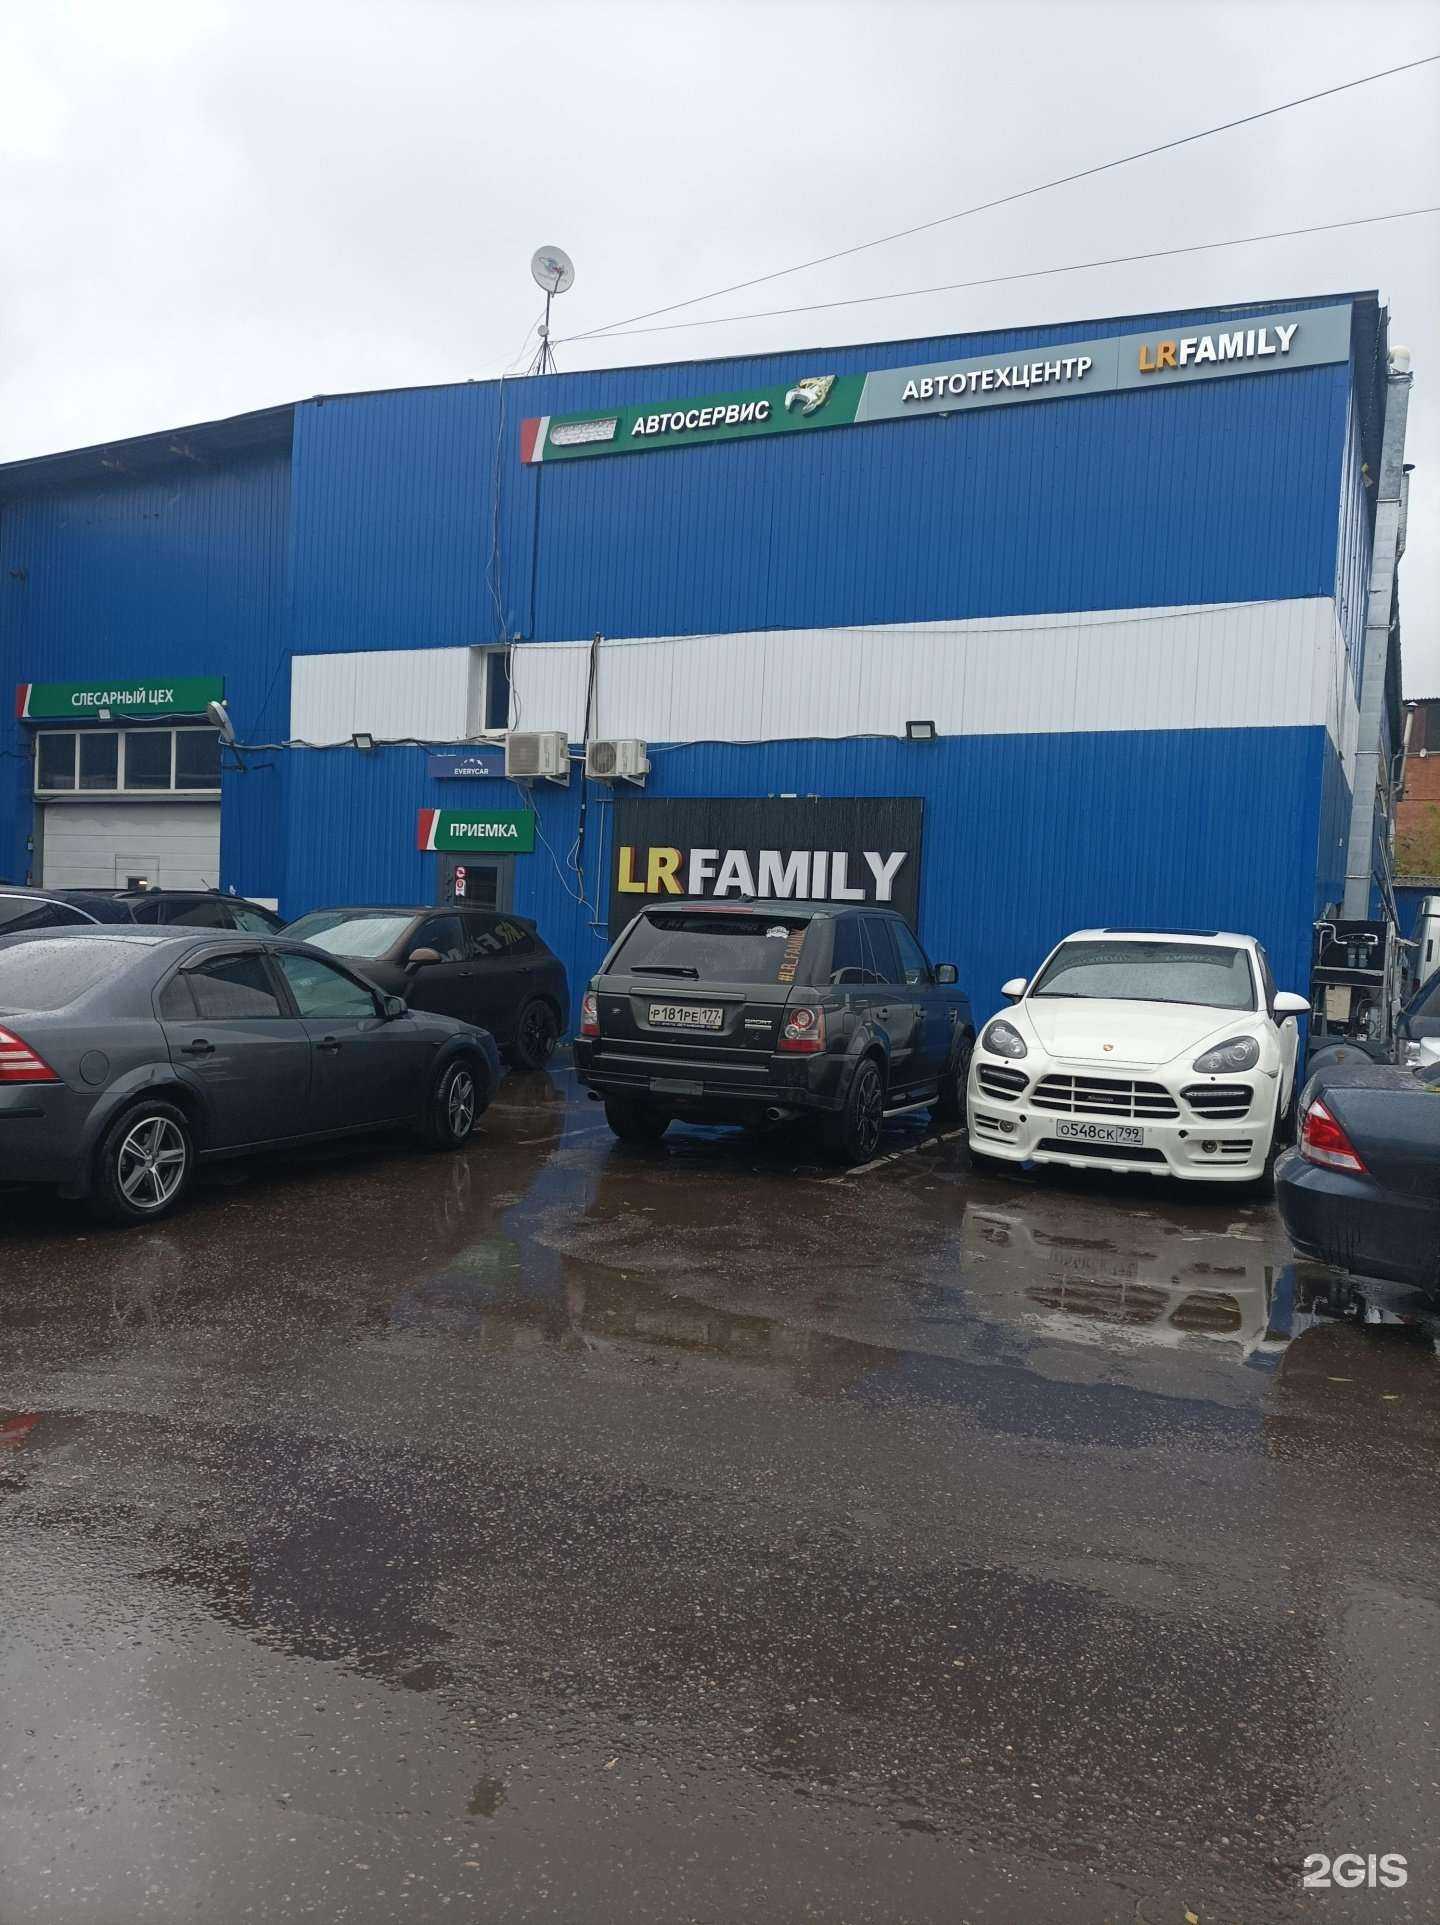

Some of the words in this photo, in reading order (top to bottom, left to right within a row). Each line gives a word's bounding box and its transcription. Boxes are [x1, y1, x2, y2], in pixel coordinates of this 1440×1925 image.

[1138, 324, 1298, 373] LRFAMILY
[902, 356, 1092, 401] АВТОТЕХЦЕНТР
[631, 400, 770, 437] АВТОСЕРВИС
[71, 687, 146, 706] СЛЕСАРНЫЙ
[148, 689, 174, 705] ЦЕХ
[453, 767, 489, 775] EVERYCAR
[449, 823, 519, 838] ПРИЕМКА
[617, 846, 908, 901] LRFAMILY
